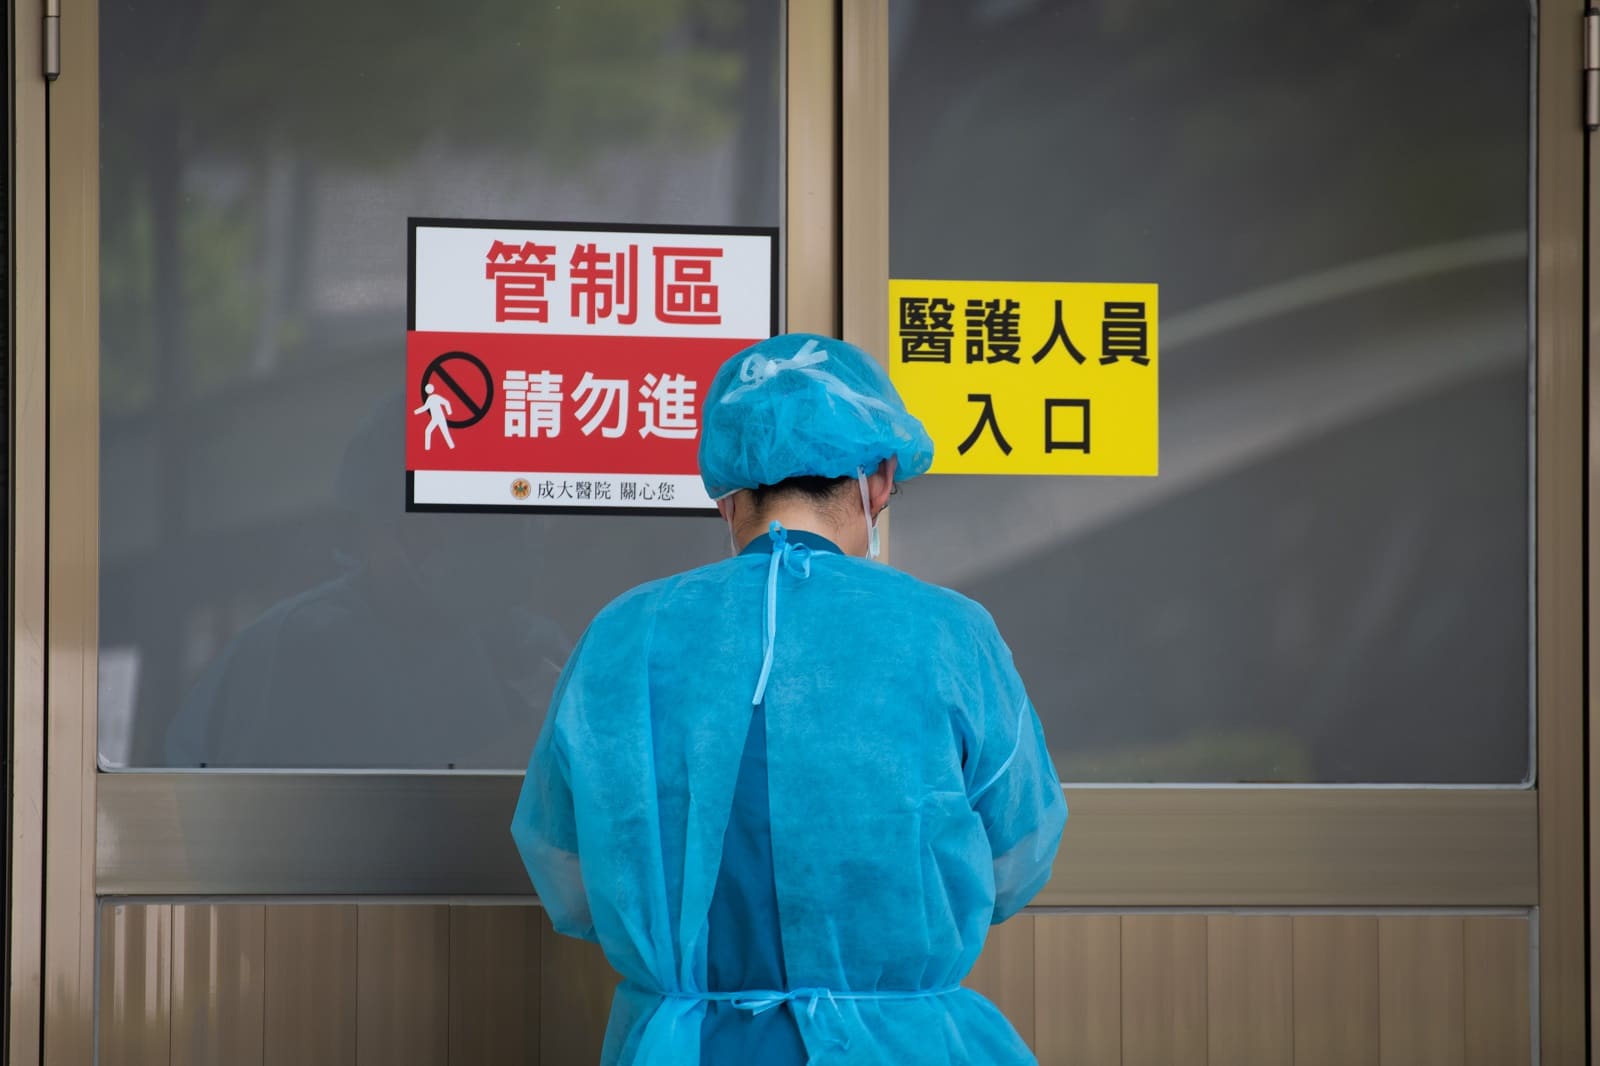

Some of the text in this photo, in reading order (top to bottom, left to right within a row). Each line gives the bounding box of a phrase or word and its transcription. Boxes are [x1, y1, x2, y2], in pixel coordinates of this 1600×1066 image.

[485, 240, 724, 325] 管制區
[899, 297, 1150, 366] 醫護人員
[503, 370, 698, 439] 請勿進
[957, 394, 1090, 456] 入口
[537, 480, 675, 501] 成大醫院 關心您
